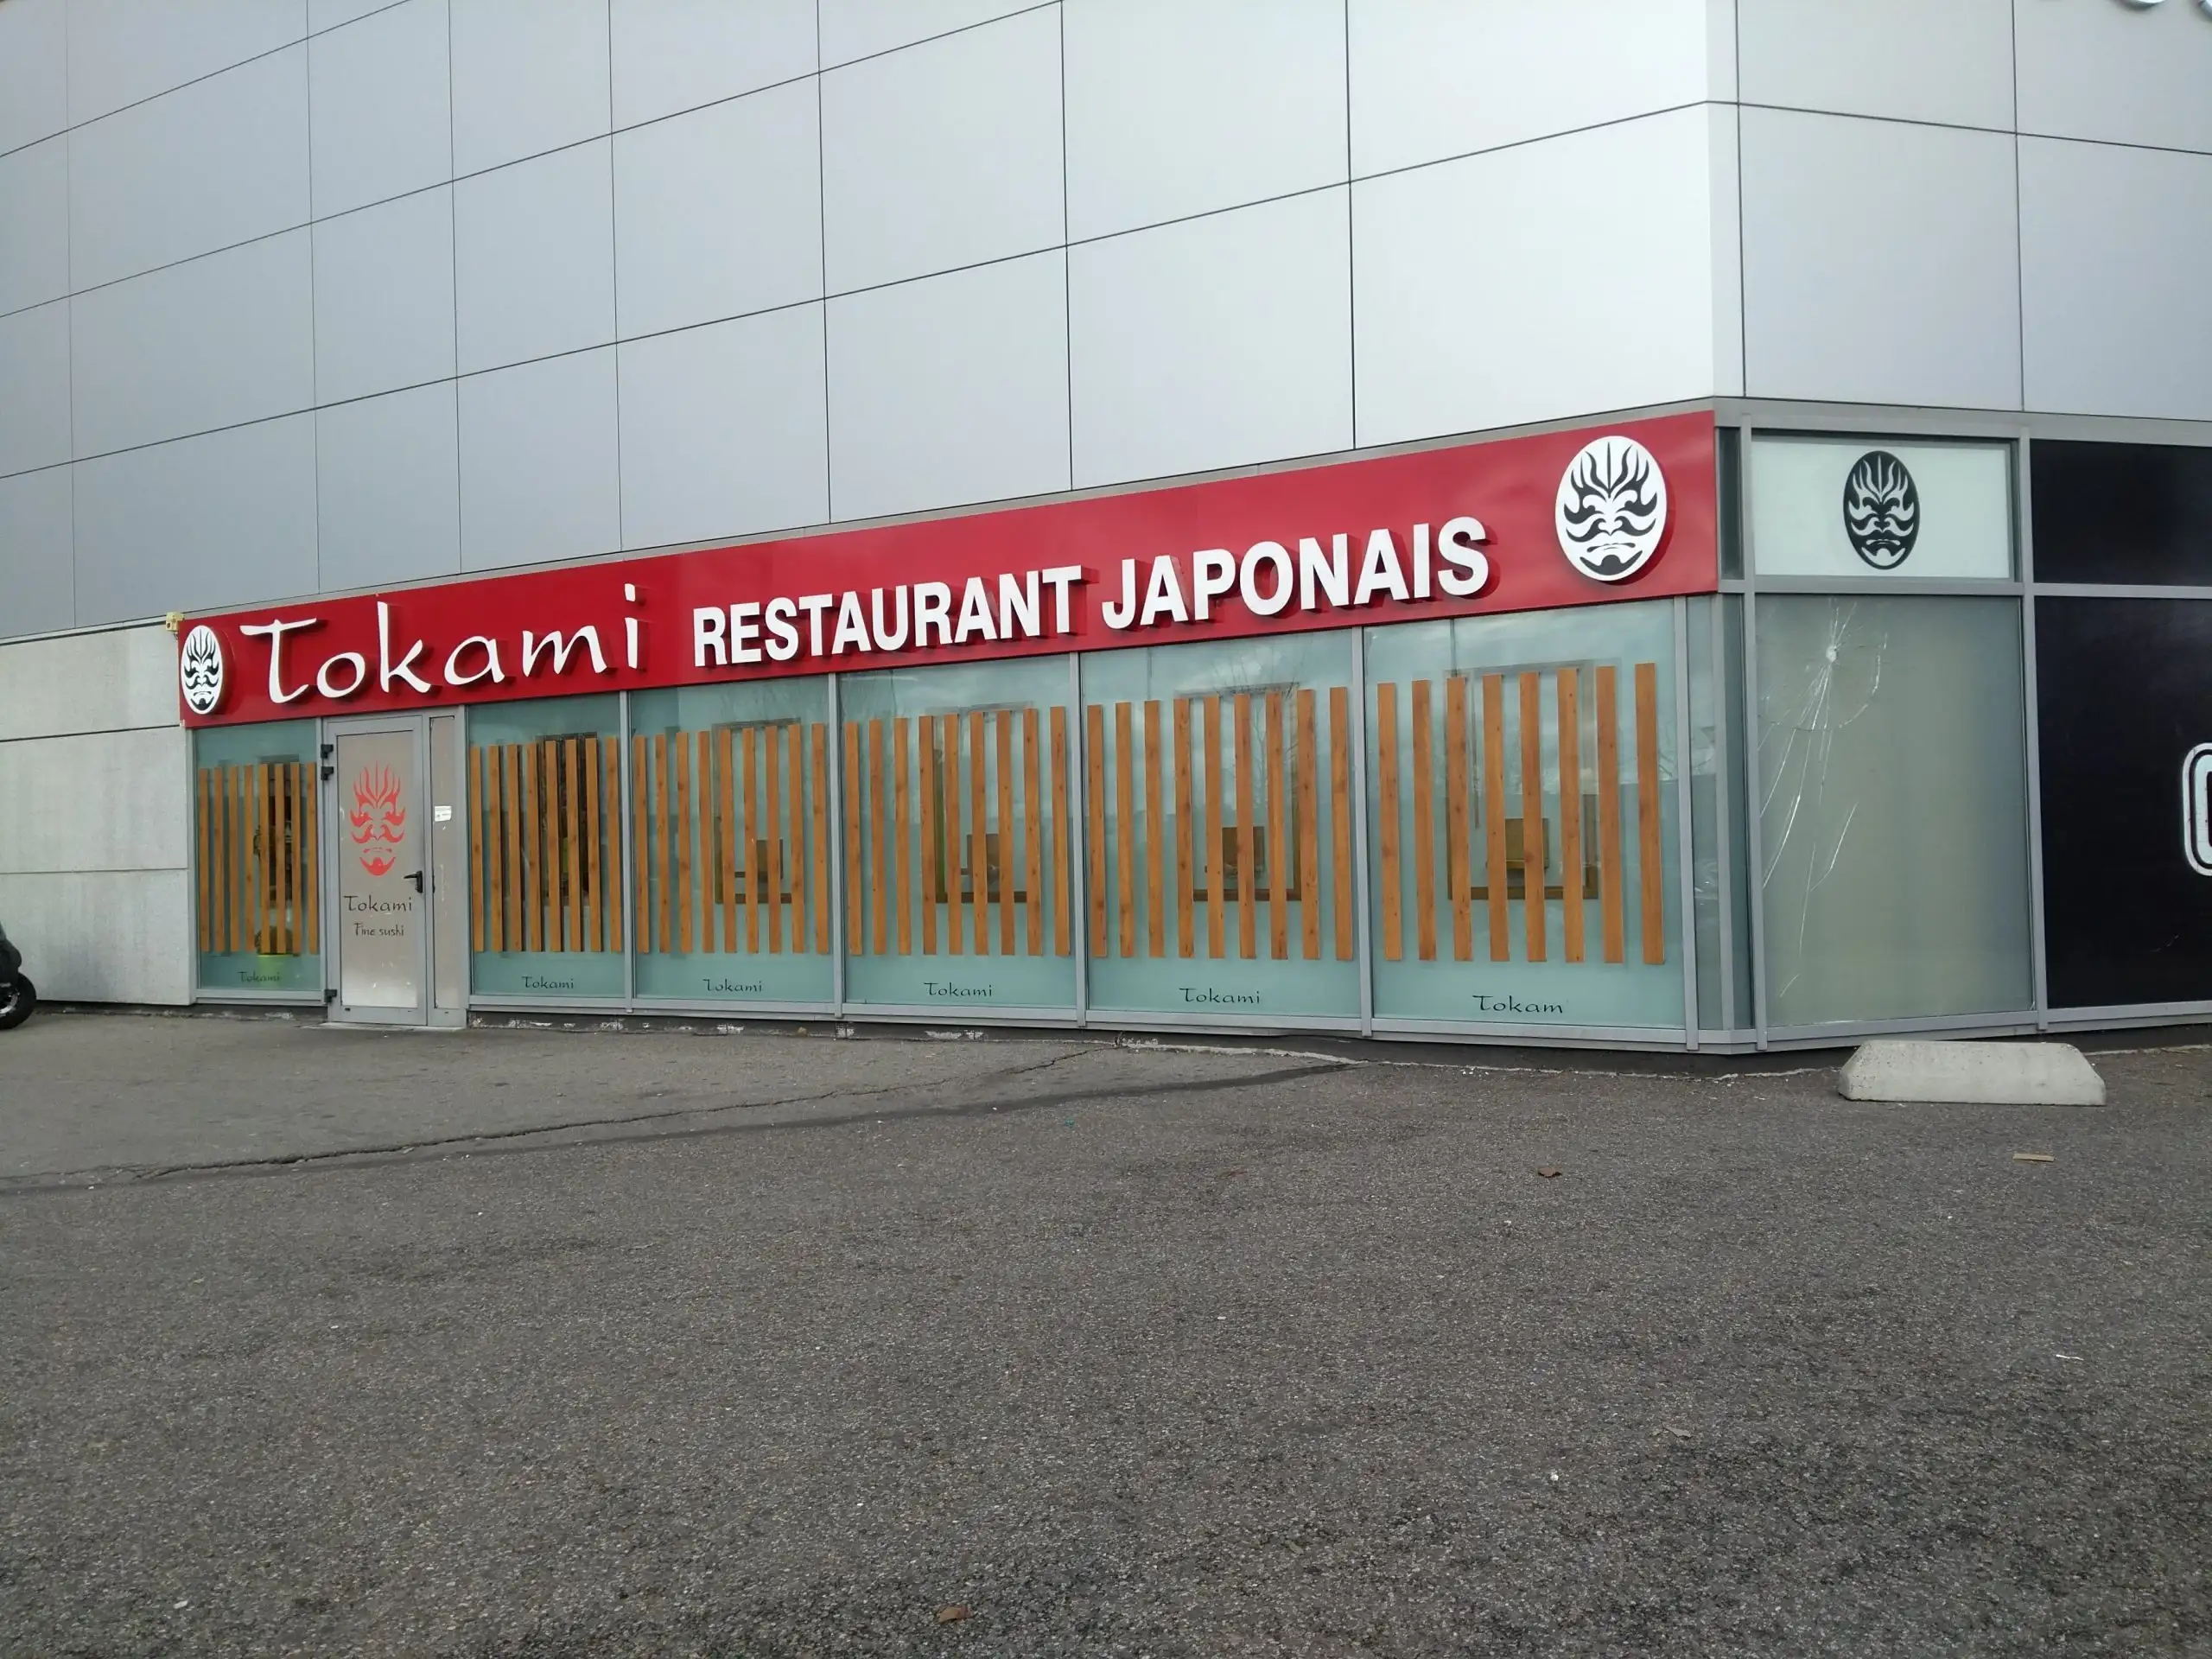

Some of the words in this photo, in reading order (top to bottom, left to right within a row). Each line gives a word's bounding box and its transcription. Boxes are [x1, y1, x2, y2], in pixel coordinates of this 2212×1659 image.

[239, 583, 639, 703] Tokami
[693, 565, 1083, 667] RESTAURANT
[1102, 517, 1490, 629] JAPONAIS
[343, 894, 412, 912] Tokami
[379, 925, 404, 936] sushi
[237, 969, 280, 982] Tokami
[521, 976, 574, 988] Tokami
[923, 982, 992, 997] Tokami
[1179, 988, 1260, 1004] Tokami
